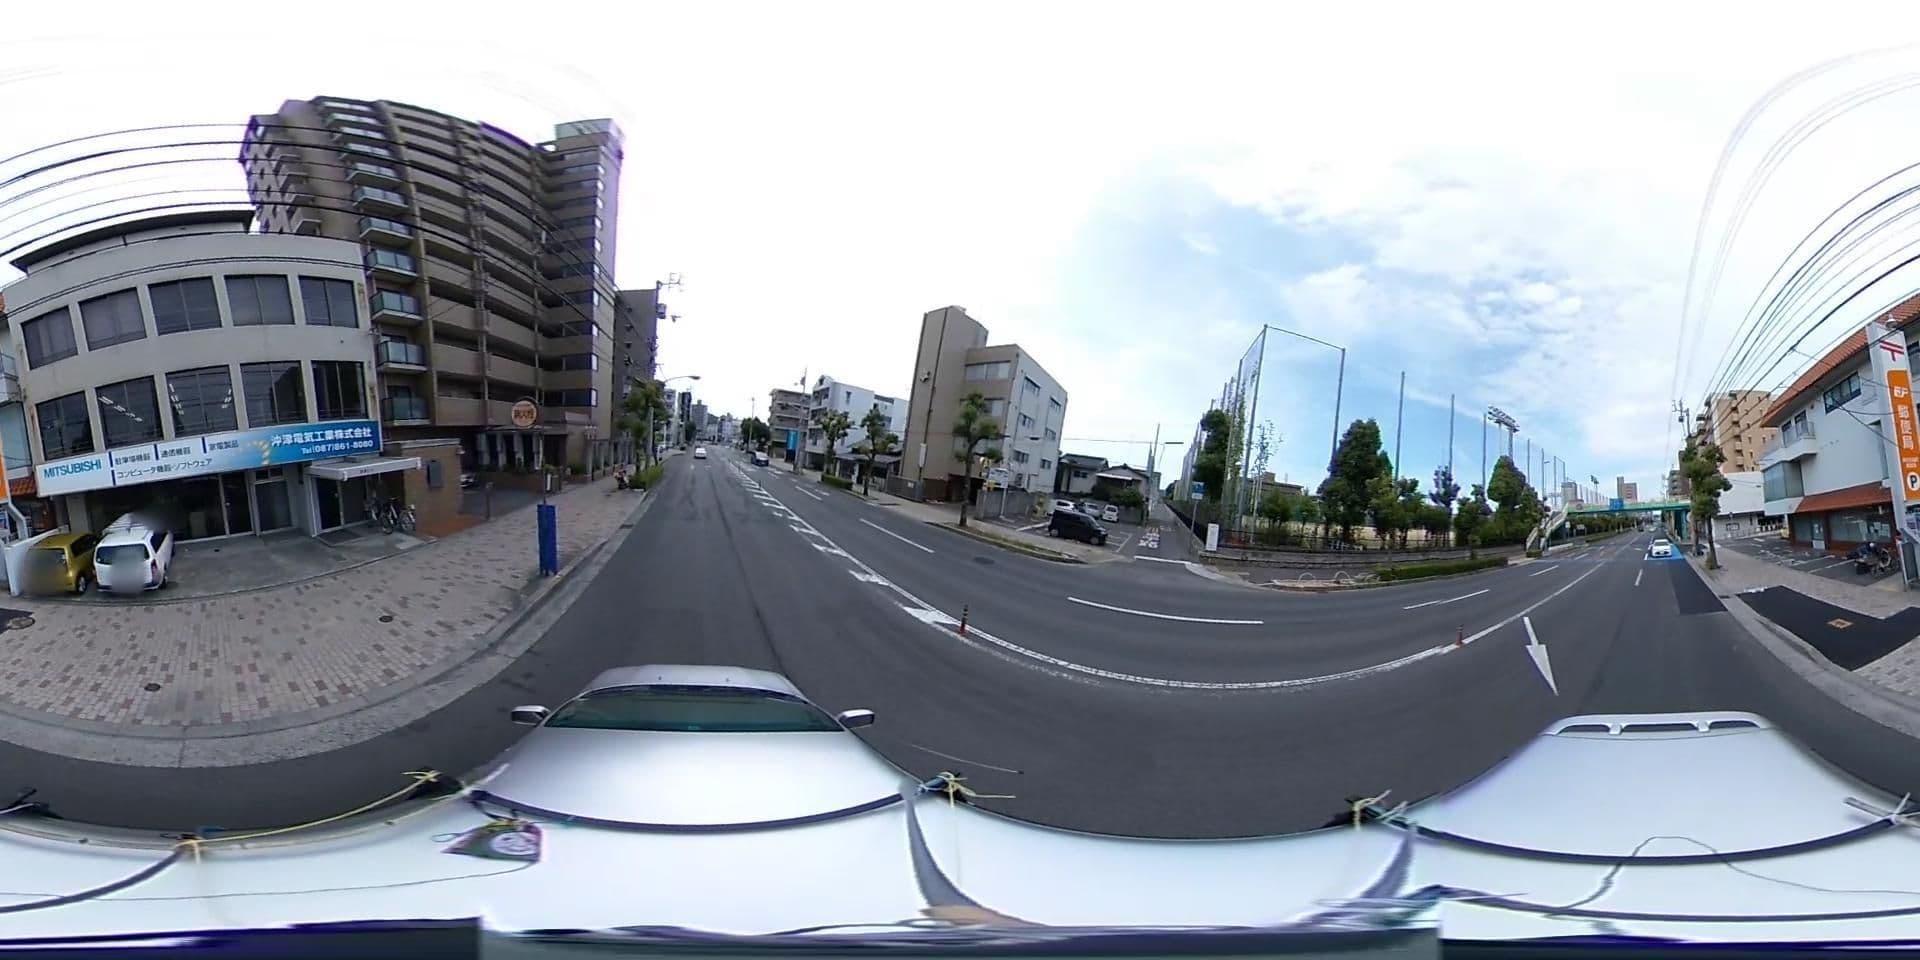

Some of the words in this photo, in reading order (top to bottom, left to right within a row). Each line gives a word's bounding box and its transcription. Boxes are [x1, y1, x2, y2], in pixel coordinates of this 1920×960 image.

[1898, 404, 1914, 450] 郵便局
[43, 459, 102, 479] MITSUBISHI
